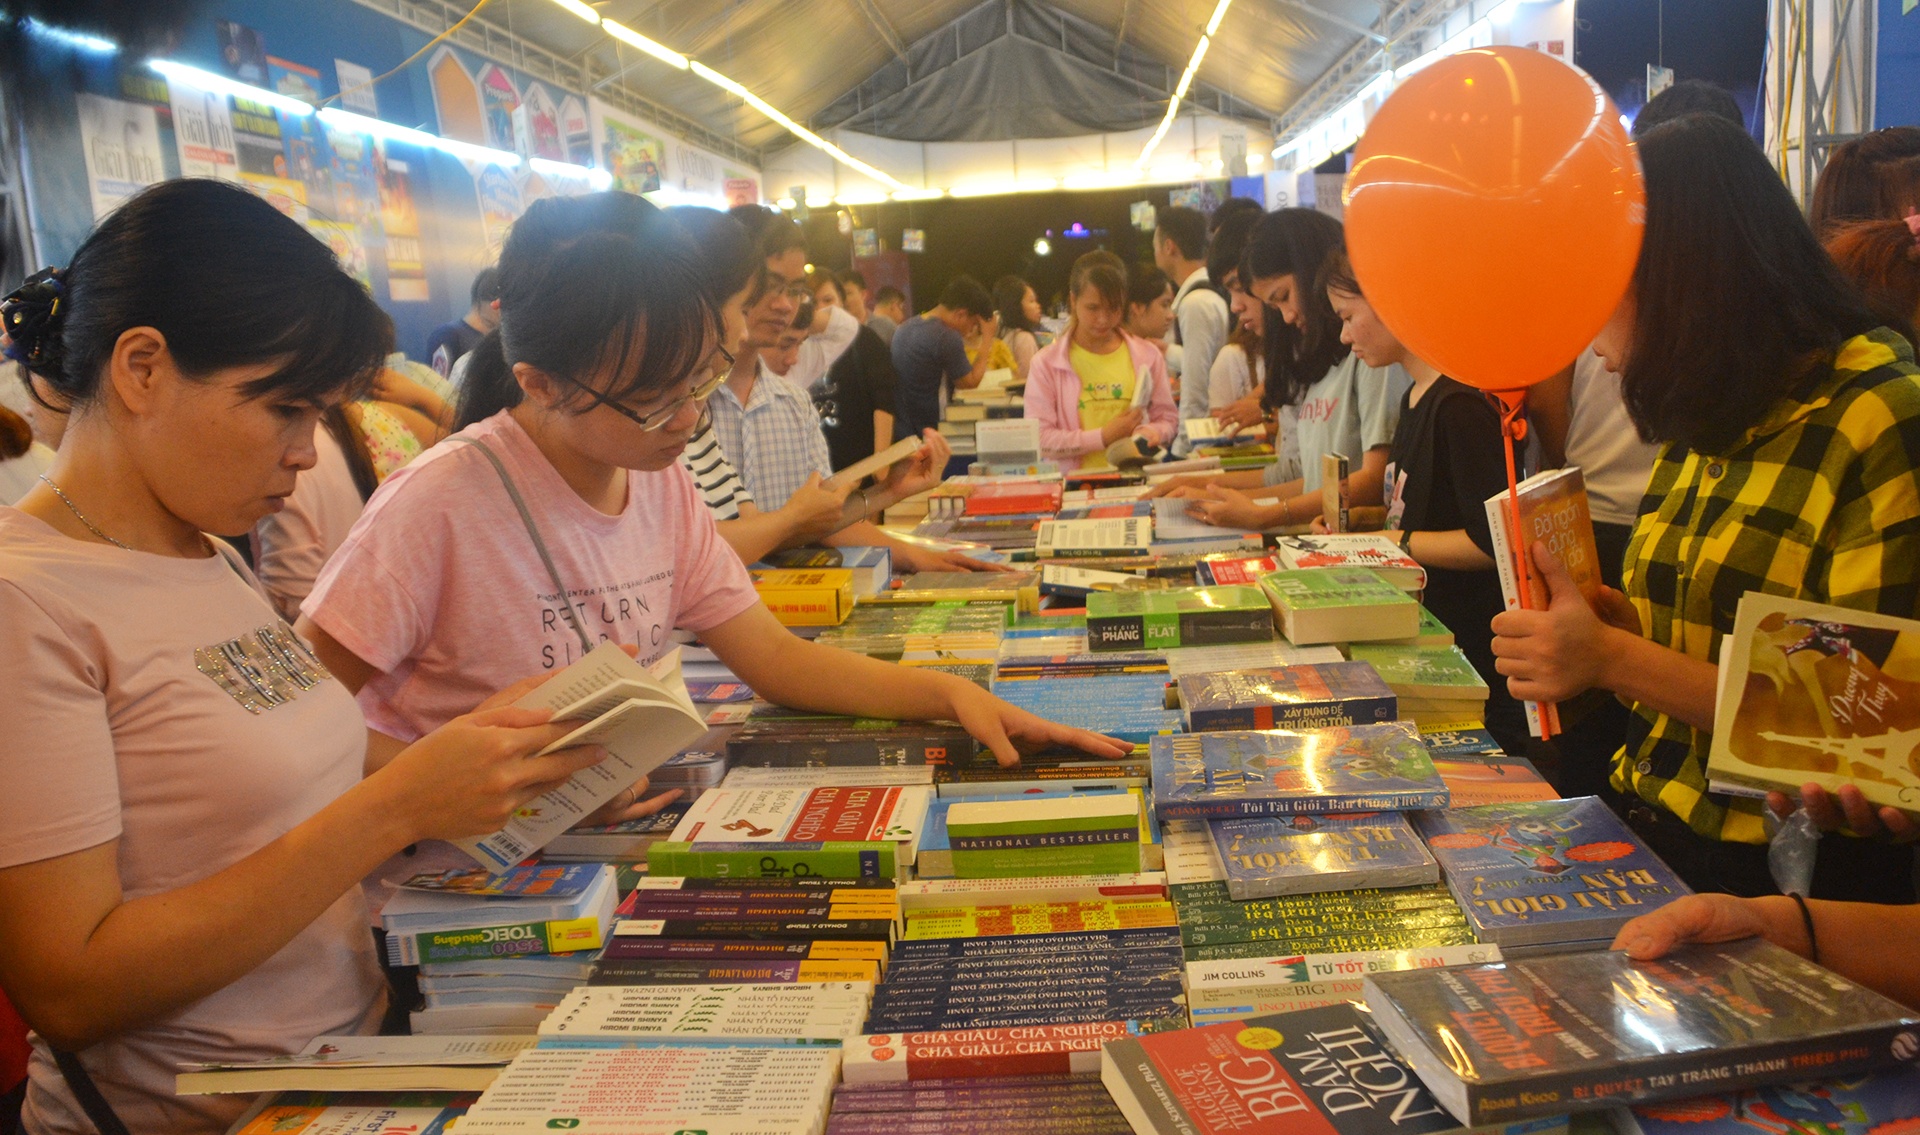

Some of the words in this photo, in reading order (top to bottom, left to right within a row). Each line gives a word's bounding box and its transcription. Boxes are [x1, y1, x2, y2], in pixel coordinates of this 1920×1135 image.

[1148, 626, 1176, 639] FLAT
[1241, 800, 1264, 813] Tôi
[1267, 799, 1291, 813] Tài
[961, 838, 1031, 848] NATIONAL
[1040, 832, 1131, 845] BESTSELLER
[481, 926, 536, 942] TOEIC
[1202, 973, 1219, 982] JIM
[1221, 969, 1265, 980] COLLINS
[1313, 962, 1334, 976] TỪ
[1335, 959, 1364, 975] TỐT
[1295, 983, 1326, 997] BIG
[766, 1027, 804, 1036] ENZYME
[911, 1031, 948, 1045] CHA
[954, 1025, 1003, 1043] GIÀU,
[1009, 1026, 1044, 1040] CHA
[1052, 1020, 1117, 1038] NGHÈO
[915, 1045, 954, 1058] CHA
[959, 1040, 1009, 1057] GIÀU,
[1016, 1040, 1054, 1054] CHA
[1174, 1067, 1200, 1087] OF
[1285, 1046, 1376, 1117] DÁM
[1304, 1024, 1446, 1126] NGHĨ
[1649, 1074, 1677, 1089] TAY
[1191, 1061, 1253, 1131] THINKING
[1218, 1055, 1310, 1122] BIG
[1187, 1084, 1233, 1132] MAGIC
